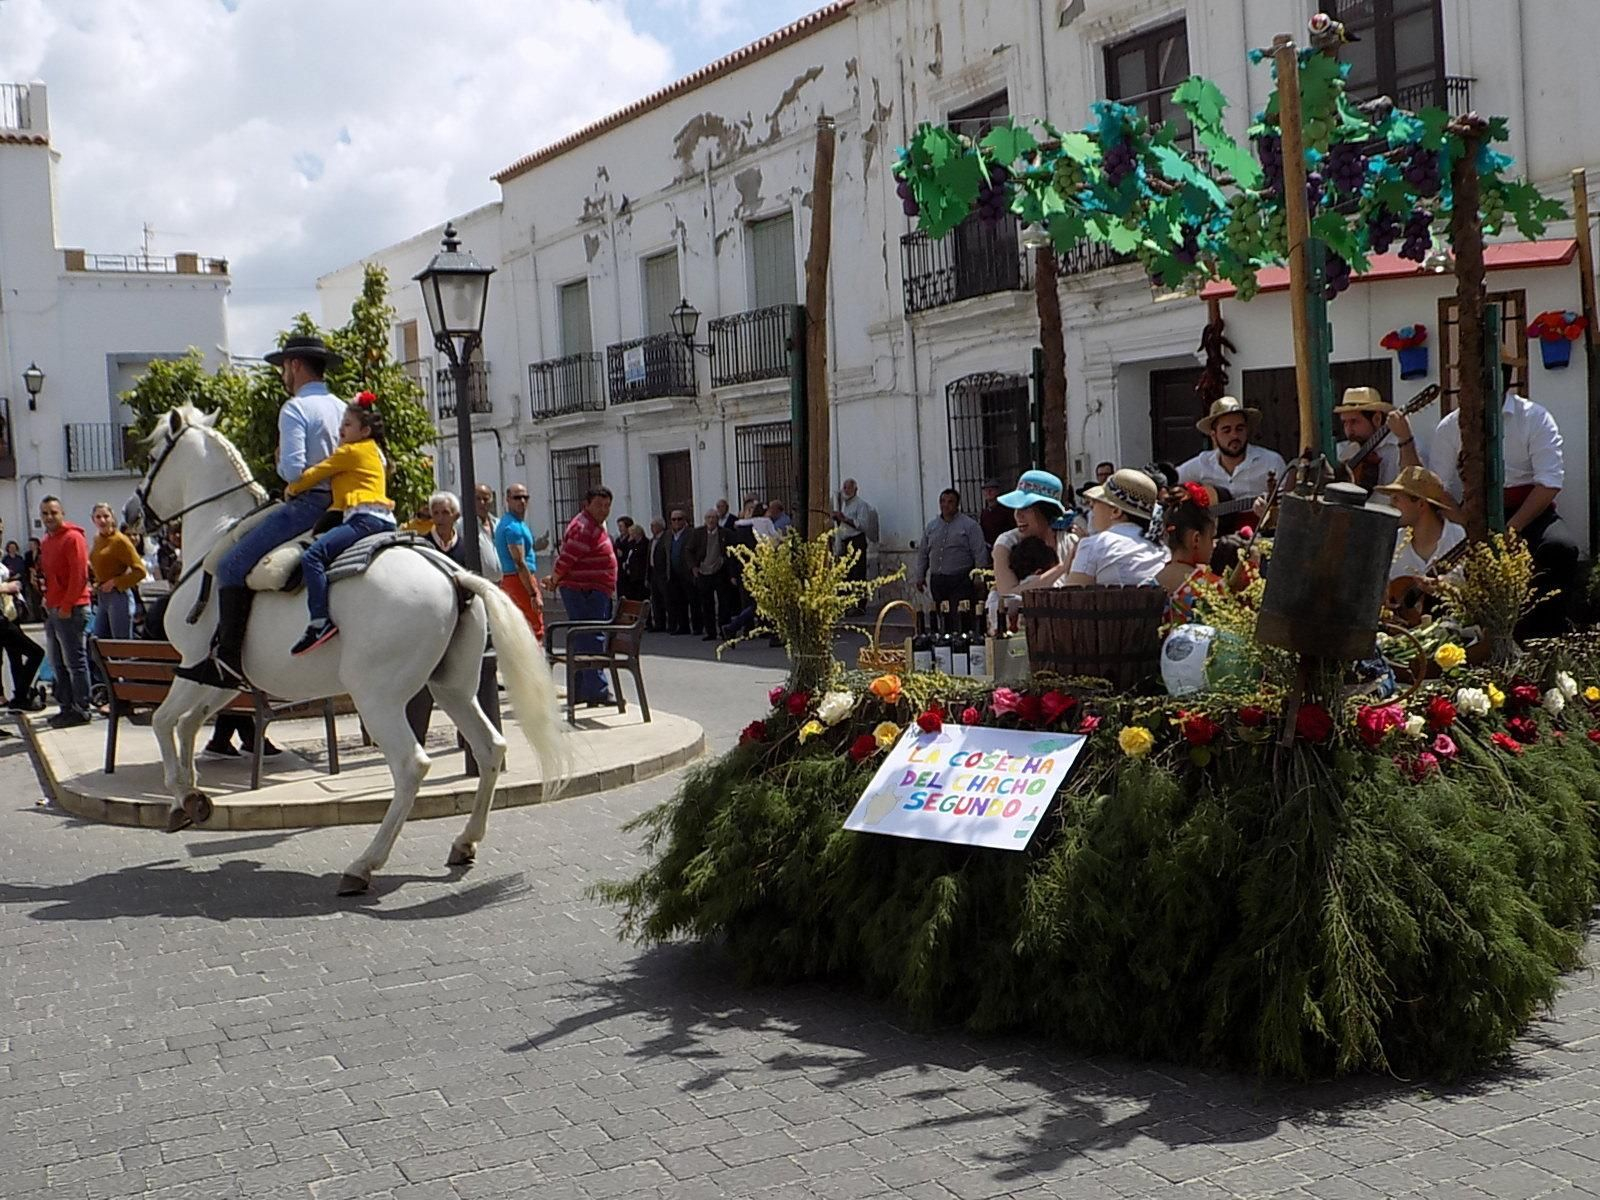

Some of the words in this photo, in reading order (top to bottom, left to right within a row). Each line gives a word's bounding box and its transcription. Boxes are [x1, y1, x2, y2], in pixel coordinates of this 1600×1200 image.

[908, 746, 941, 764] LA
[949, 752, 1055, 775] COSECHA
[900, 770, 943, 789] DEL
[952, 775, 1047, 795] CHACHO
[903, 791, 1022, 818] SEGUNDO
